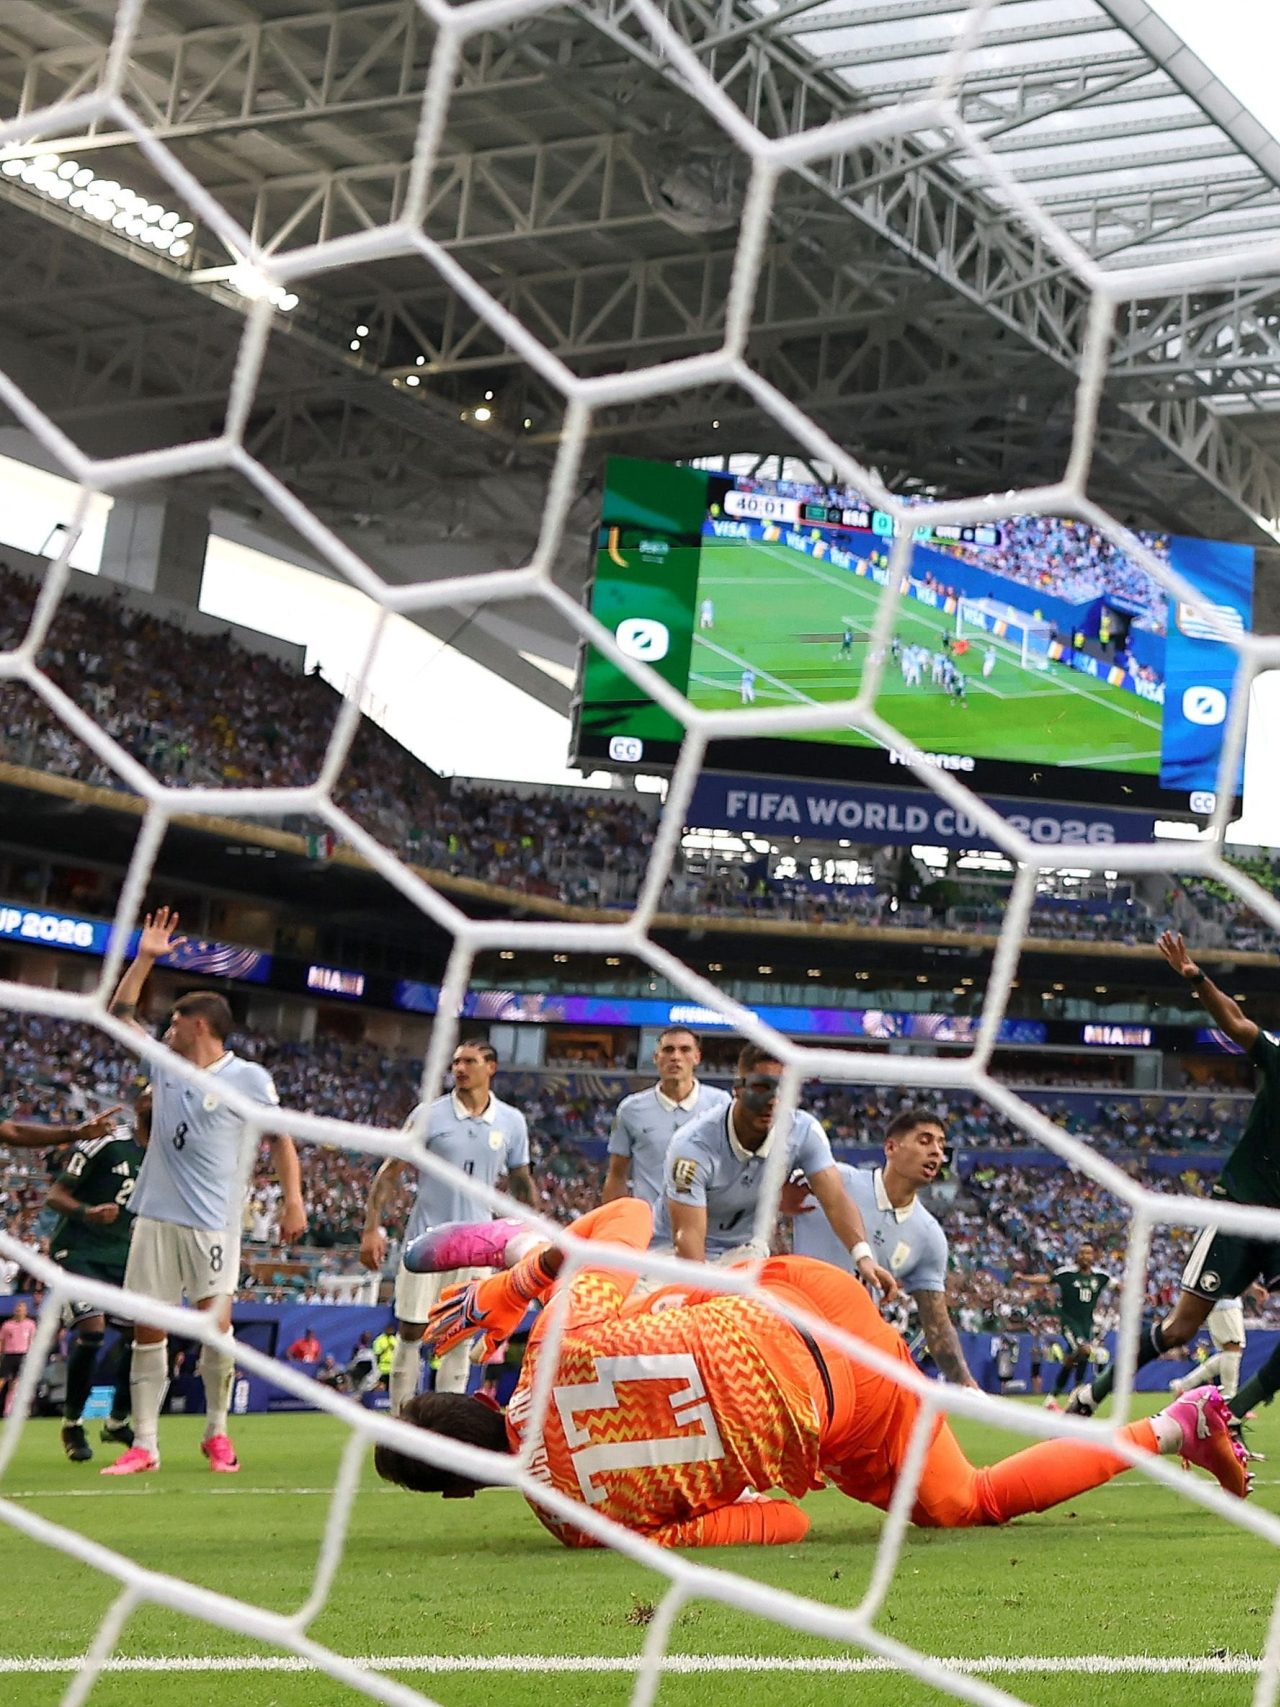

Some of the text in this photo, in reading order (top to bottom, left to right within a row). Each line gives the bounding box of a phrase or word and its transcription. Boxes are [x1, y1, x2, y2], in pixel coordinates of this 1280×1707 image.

[713, 520, 749, 538] VISA
[614, 742, 638, 758] CC
[1193, 796, 1213, 812] CC
[726, 791, 799, 822] FIFA
[807, 796, 929, 833] WORLD
[1005, 814, 1115, 846] 2026
[20, 912, 94, 948] 2026
[173, 1122, 188, 1150] 8
[210, 1245, 223, 1272] 8
